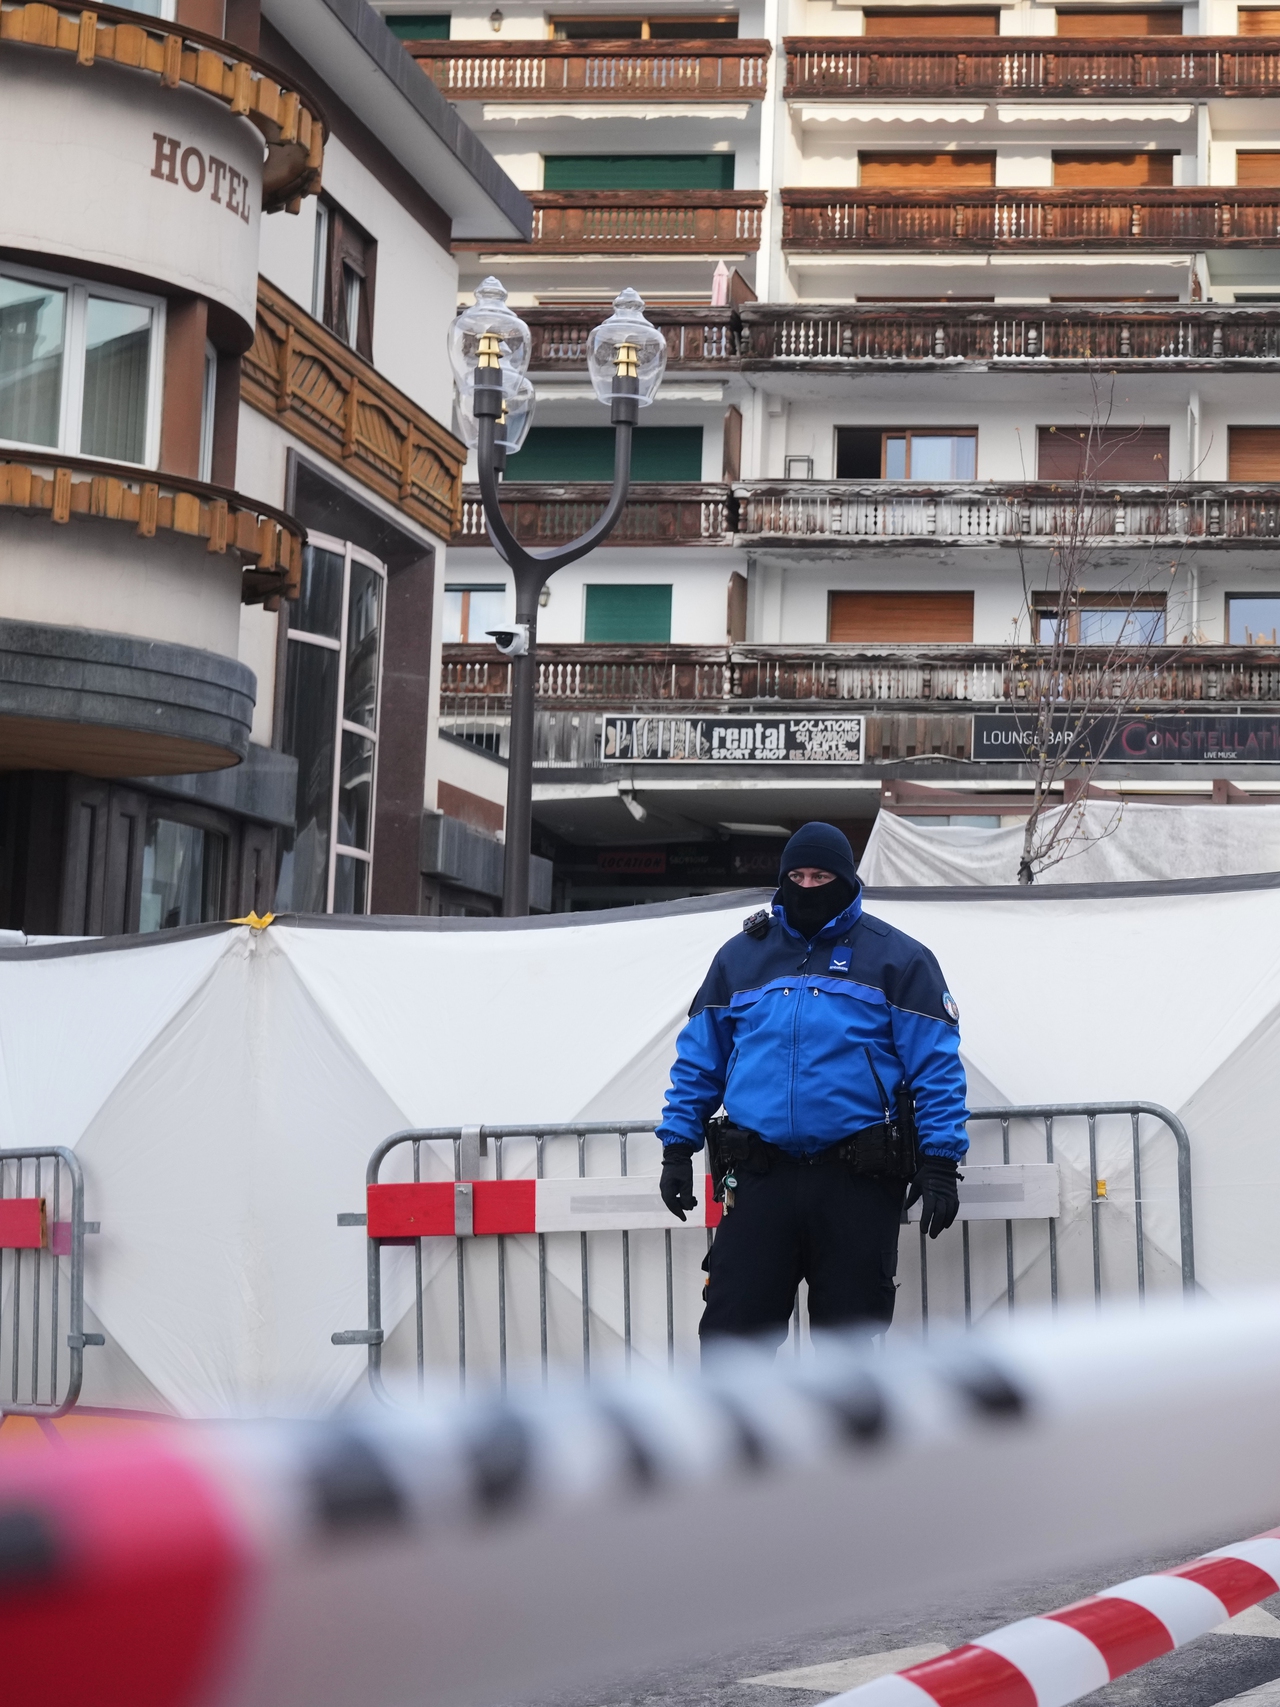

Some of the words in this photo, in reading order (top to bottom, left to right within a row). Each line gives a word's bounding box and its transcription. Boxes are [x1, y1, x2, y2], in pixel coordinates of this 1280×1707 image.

[150, 131, 250, 226] HOTEL
[789, 720, 860, 732] LOCATIONS
[712, 723, 786, 749] rental
[983, 730, 1042, 745] LOUNGE
[1047, 730, 1075, 745] BAR
[804, 740, 849, 751] VENTE
[711, 748, 751, 760] SPORT
[754, 748, 787, 760] SHOP
[1204, 751, 1217, 759] LIVE
[1218, 751, 1238, 759] MUSIC
[600, 856, 663, 869] LOCATION
